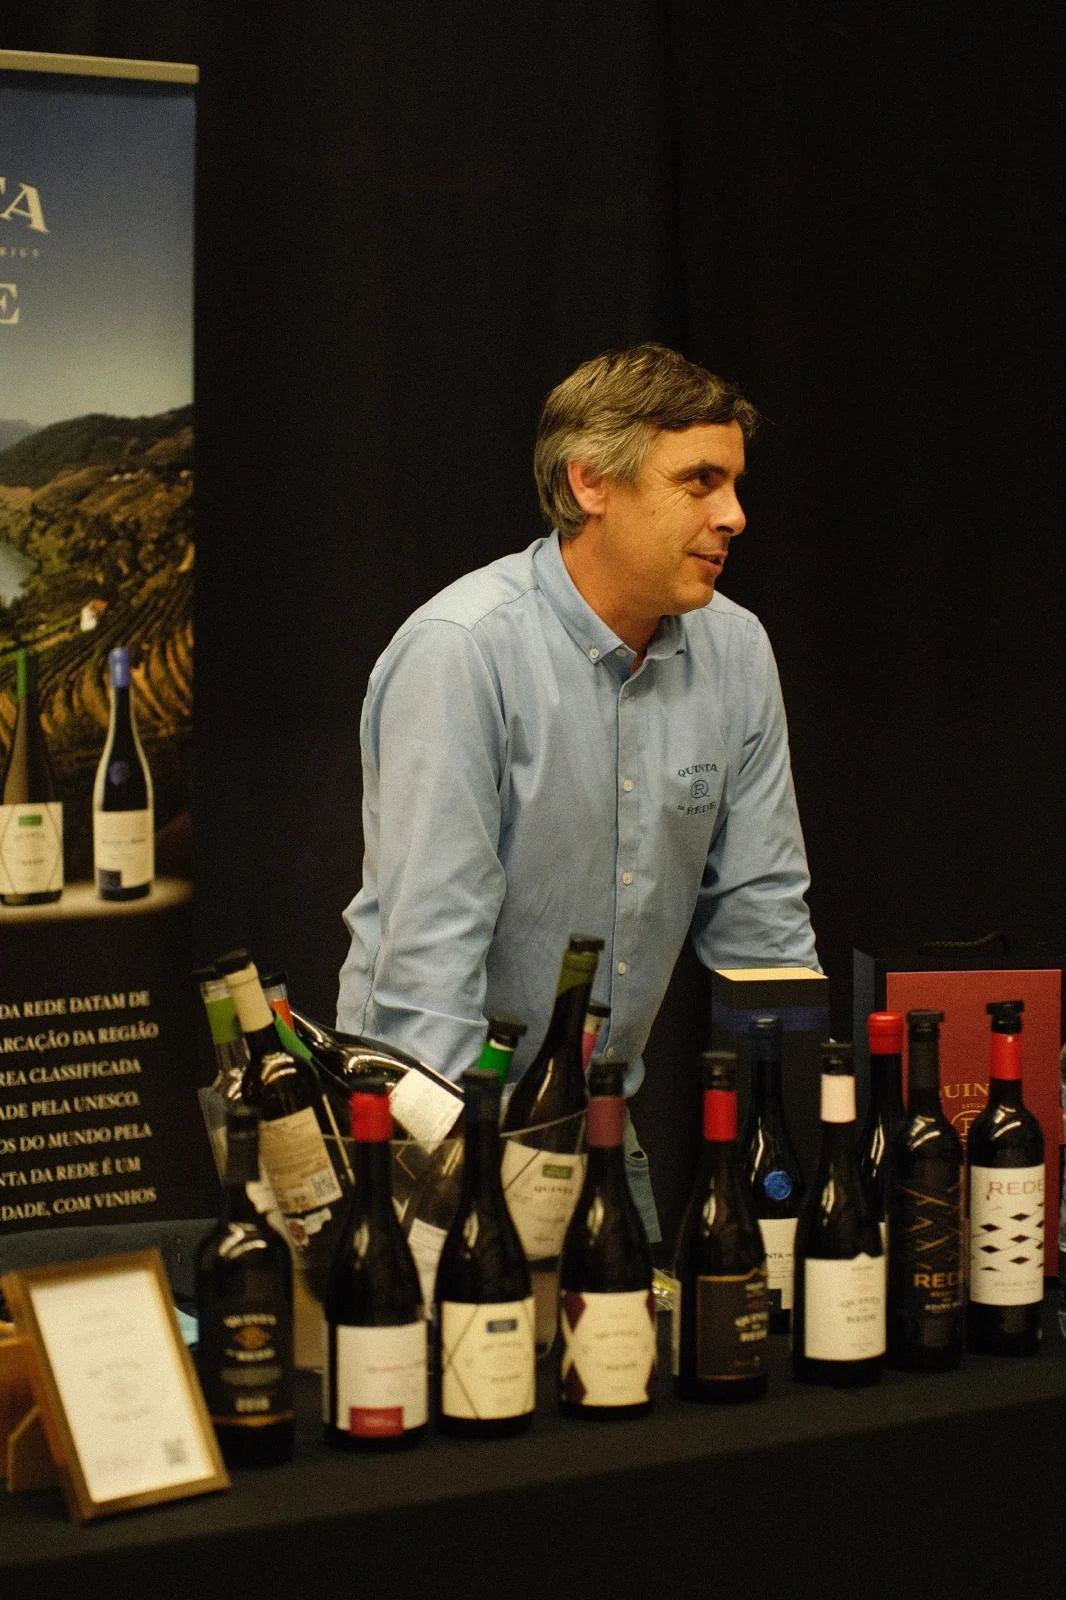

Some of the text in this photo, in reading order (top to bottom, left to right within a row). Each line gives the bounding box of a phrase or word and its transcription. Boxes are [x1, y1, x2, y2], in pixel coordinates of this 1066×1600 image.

[678, 763, 718, 778] QUINTA
[686, 801, 717, 816] REDE
[24, 998, 66, 1017] REDE
[70, 993, 126, 1013] DATAM
[129, 990, 150, 1008] DE
[73, 1028, 95, 1046] DA
[99, 1020, 159, 1044] REGIÃO
[29, 1058, 141, 1084] CLASSIFICADA
[939, 1082, 990, 1102] UIN
[31, 1097, 71, 1117] PELA
[20, 1135, 45, 1153] DO
[48, 1128, 111, 1148] MUNDO
[114, 1122, 153, 1142] PELA
[31, 1167, 53, 1185] DA
[56, 1160, 99, 1182] REDE
[101, 1157, 112, 1176] É
[115, 1155, 141, 1173] UM
[53, 1194, 91, 1215] COM
[93, 1187, 157, 1211] VINHOS
